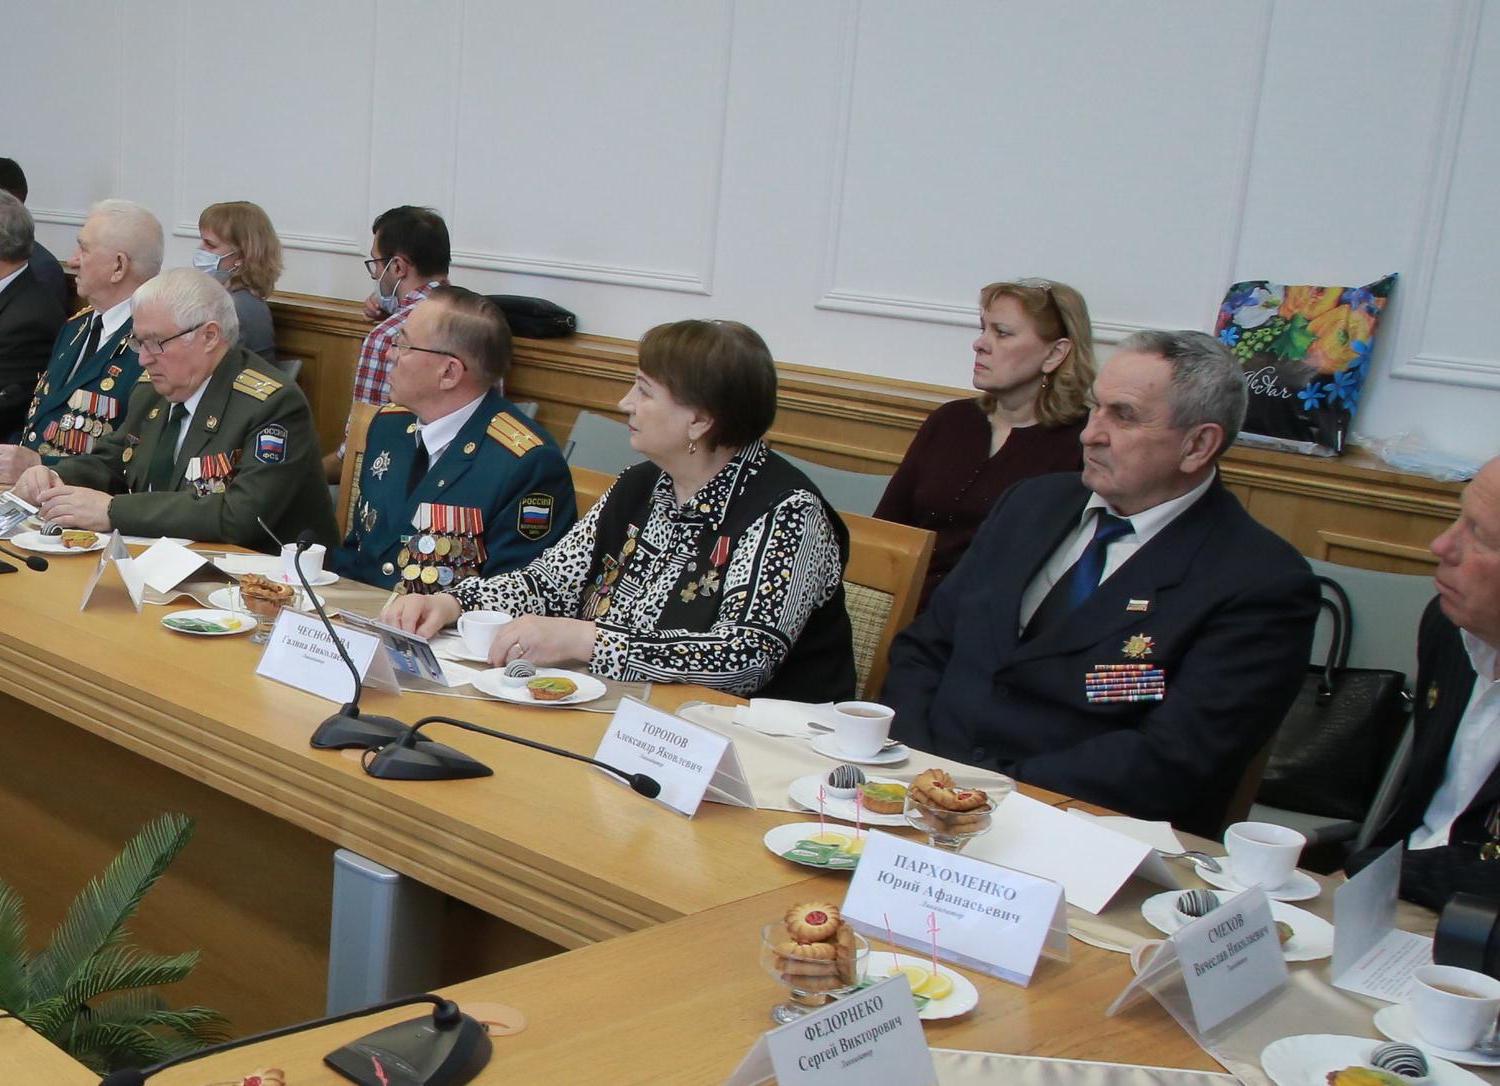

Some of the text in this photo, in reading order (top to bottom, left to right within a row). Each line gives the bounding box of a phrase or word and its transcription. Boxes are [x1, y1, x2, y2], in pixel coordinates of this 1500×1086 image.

[282, 635, 308, 650] Галина
[297, 624, 350, 650] ЧЕСНОКВА
[614, 729, 655, 754] Александр
[656, 745, 702, 773] Яковлевич
[642, 721, 689, 749] ТОРОПОВ
[876, 870, 1021, 924] Юрий Афанасьевич
[893, 854, 1017, 901] ПАРХОМЕНКО
[1194, 950, 1229, 977] Вячеслав
[1226, 925, 1269, 957] Николаевич
[1208, 913, 1244, 944] СМЕХОВ
[804, 995, 883, 1042] ФЕДОРНЕКО
[798, 1042, 839, 1072] Сергей
[838, 1016, 903, 1053] Викторович
